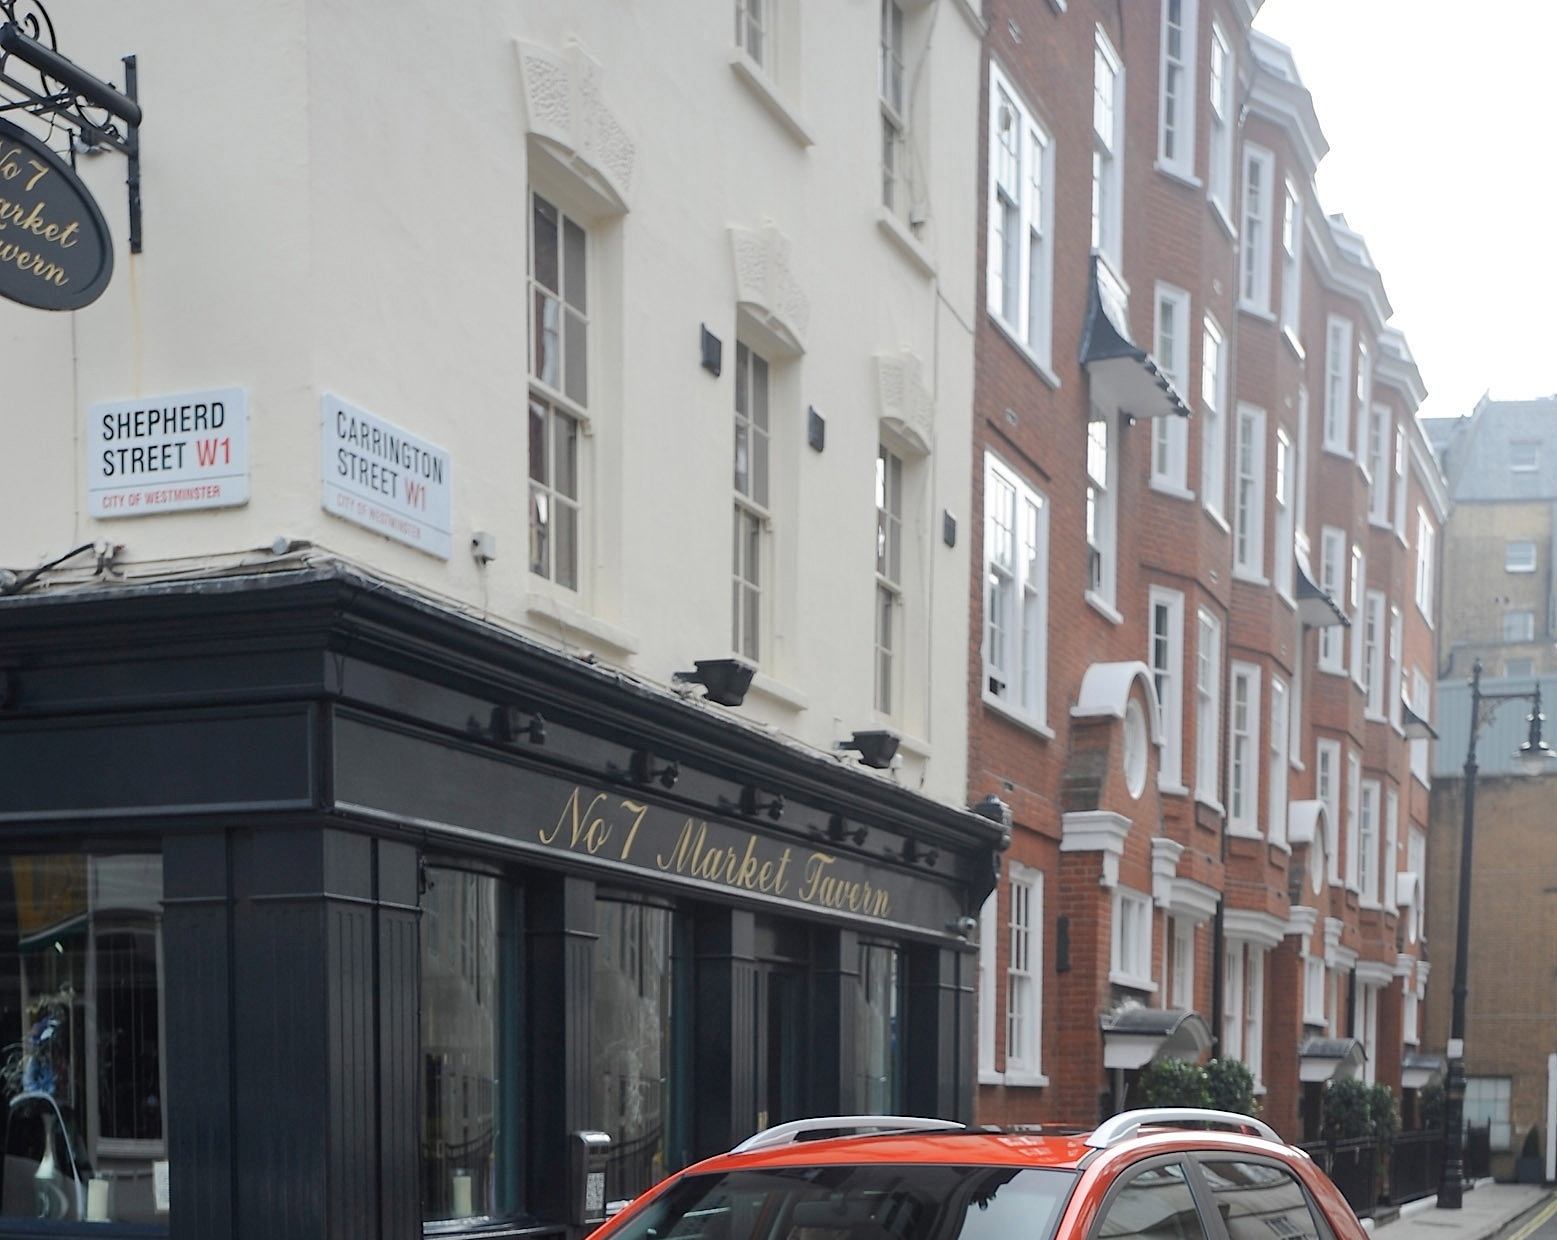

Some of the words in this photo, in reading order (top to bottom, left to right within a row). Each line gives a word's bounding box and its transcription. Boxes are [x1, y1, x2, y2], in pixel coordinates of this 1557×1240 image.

[0, 140, 22, 180] o
[25, 159, 49, 192] 7
[0, 198, 80, 249] arket
[102, 402, 225, 441] SHEPHERD
[103, 442, 187, 477] STREET
[196, 436, 231, 467] W1
[337, 411, 443, 484] CARRINGTON
[102, 494, 125, 510] CITY
[128, 492, 142, 507] OF
[145, 484, 221, 505] WESTMINSTER
[338, 448, 398, 498] STREET
[404, 477, 426, 512] W1
[538, 786, 613, 855] No
[620, 799, 649, 860] 7
[656, 816, 792, 894] Market
[798, 851, 892, 919] Tavern
